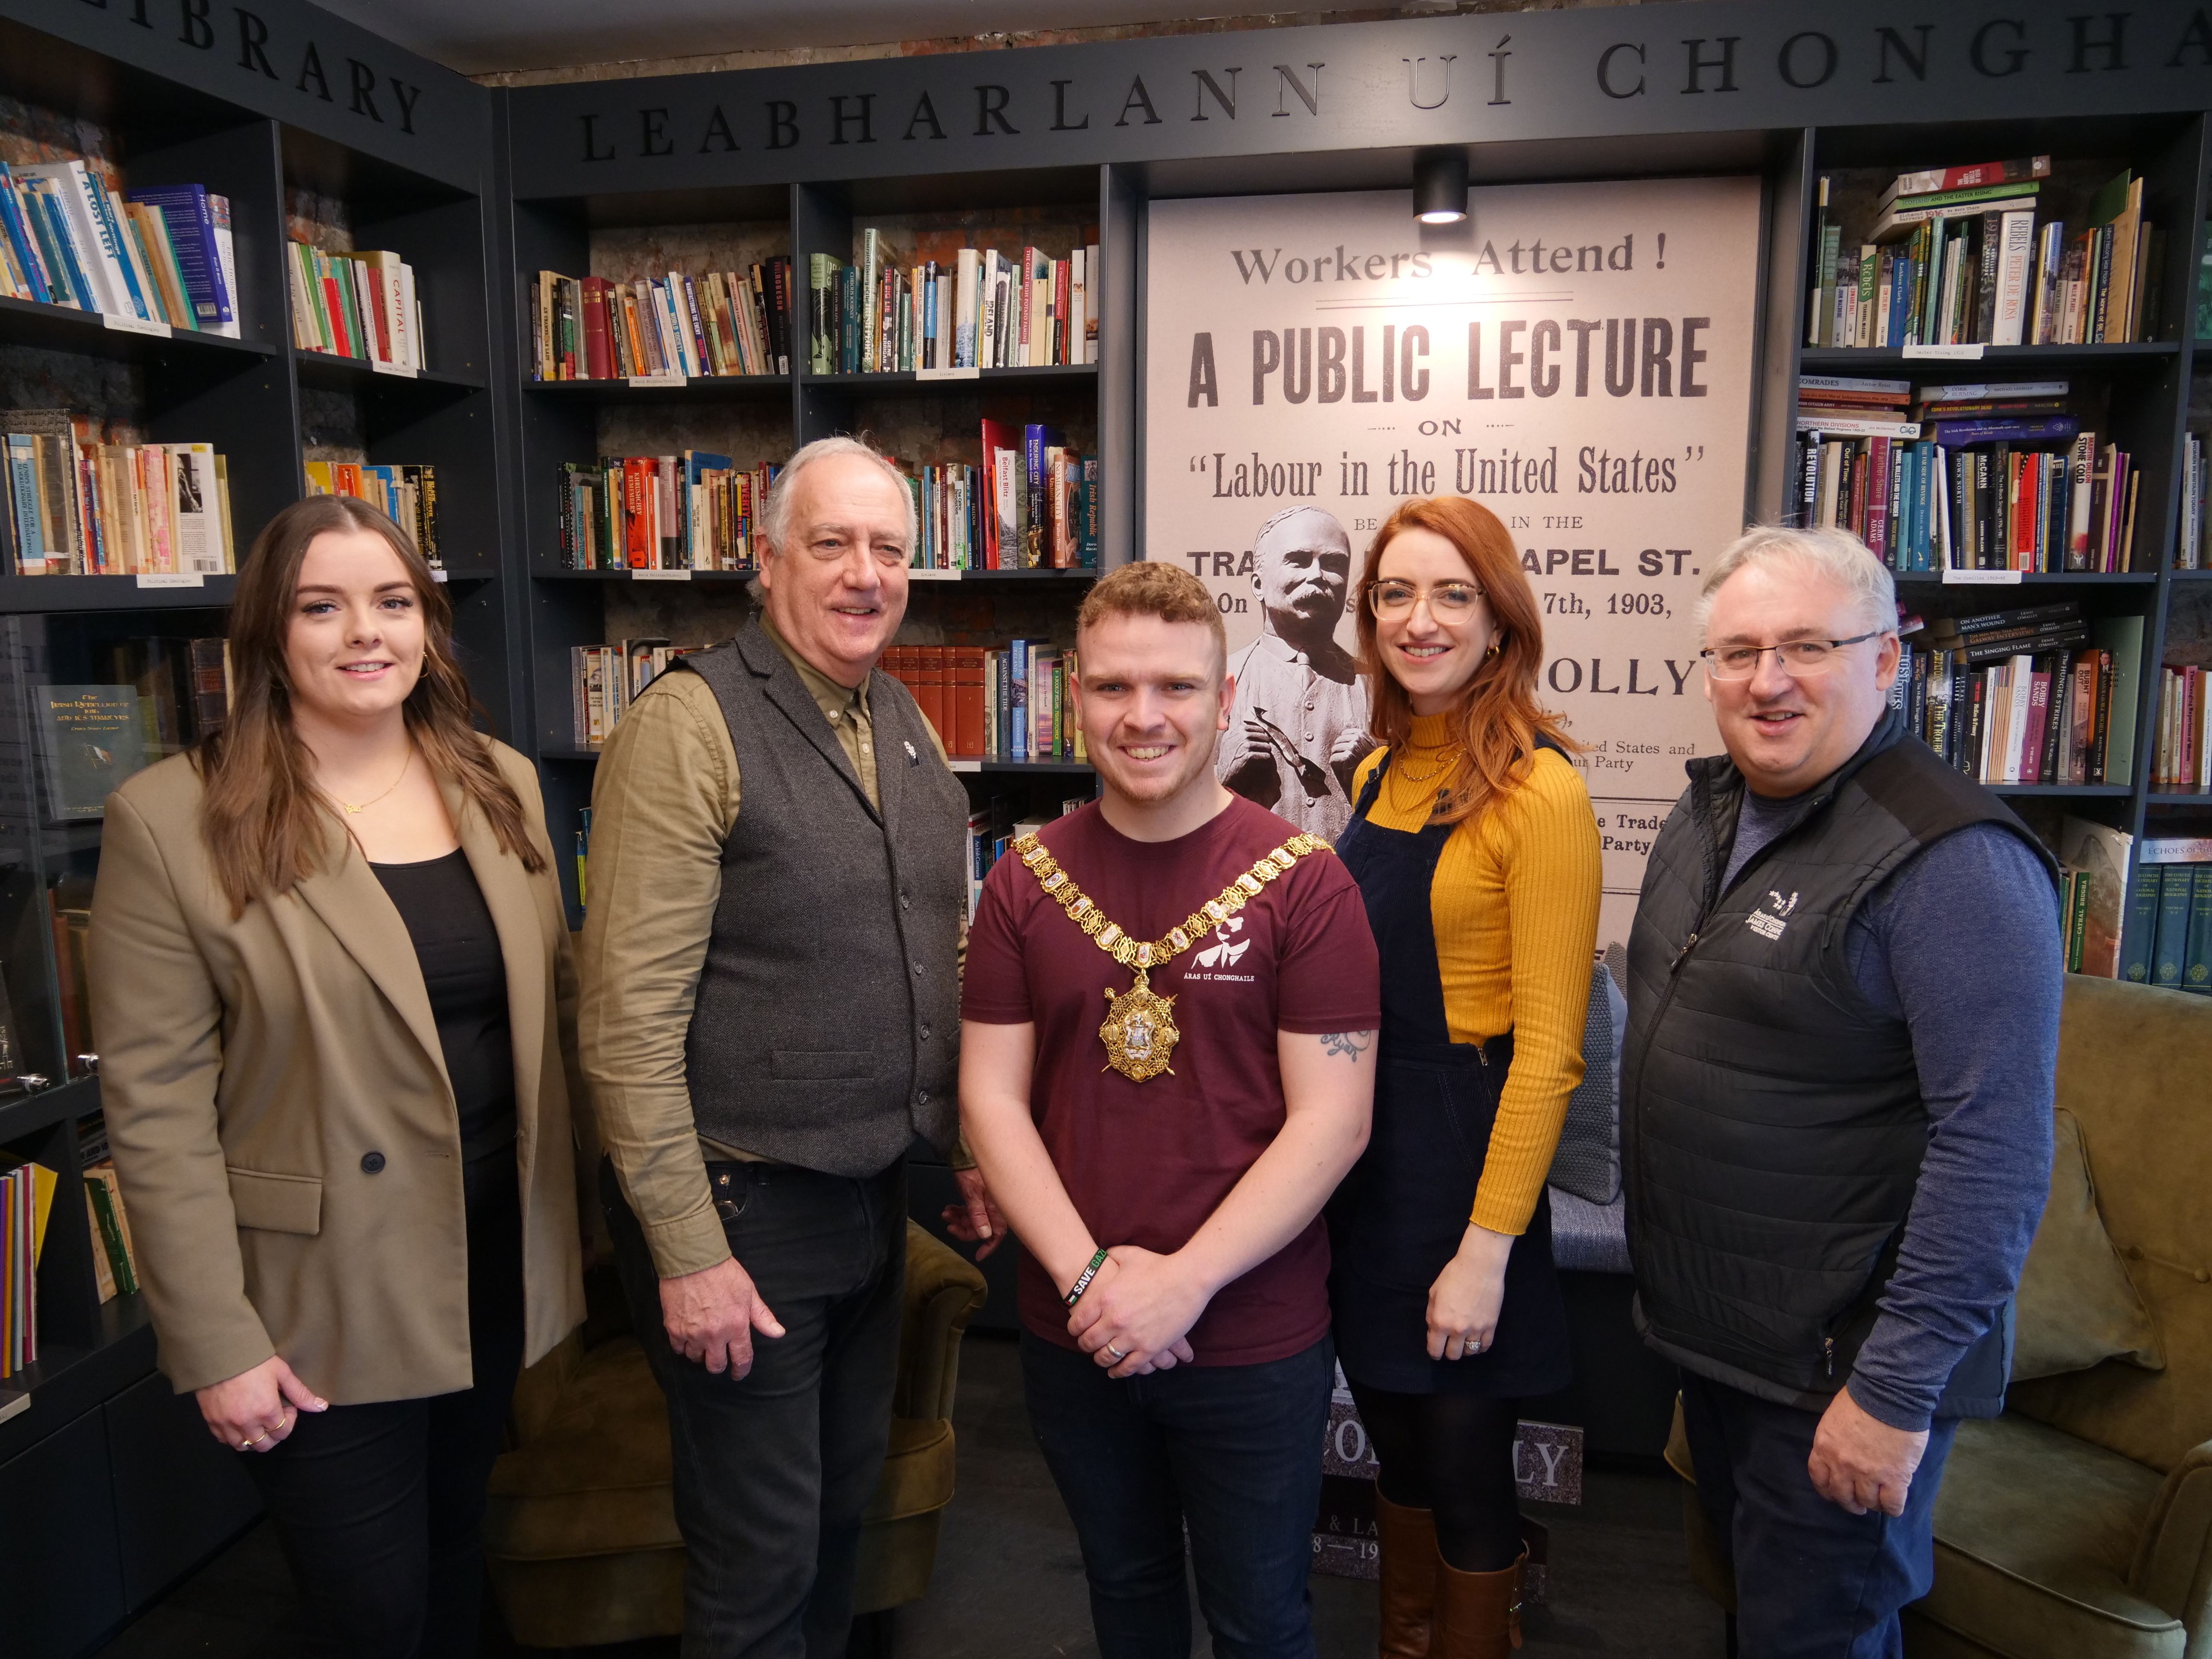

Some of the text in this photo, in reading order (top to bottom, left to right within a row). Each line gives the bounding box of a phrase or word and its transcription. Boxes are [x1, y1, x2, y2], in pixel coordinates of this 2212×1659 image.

[580, 6, 2212, 163] LEABHARLANN UÍ CHONGHA
[81, 180, 116, 259] A LOST LEFT
[198, 194, 209, 225] Home
[1230, 244, 1433, 285] Workers
[1470, 233, 1634, 276] Attend
[2005, 220, 2029, 320] REBELS PETER DE ROSA
[1861, 263, 1873, 296] Rebels
[393, 279, 404, 334] CAPITAL
[685, 282, 697, 316] MANUFACTURING
[731, 282, 739, 311] BROADWATER
[669, 312, 683, 352] WORLD SOCIETY
[985, 300, 994, 337] IRELAND
[1187, 317, 1711, 408] A PUBLIC LECTURE
[1418, 417, 1461, 437] ON
[1877, 451, 1886, 476] Farther
[2076, 437, 2087, 484] STONE COLD
[2087, 436, 2095, 463] MARTIN
[1056, 464, 1060, 473] NO
[1339, 451, 1369, 496] in
[1388, 449, 1435, 496] the
[1455, 446, 1558, 495] United
[1804, 448, 1817, 503] REVOLUTION
[741, 474, 751, 518] POVERTY
[1876, 477, 1884, 498] Shore
[17, 463, 33, 555] REVOLUTIONARY INTERNATIONAL
[1354, 516, 1583, 530] BE IN THE
[1637, 548, 1700, 576] ST.
[1217, 592, 1248, 614] On
[1607, 593, 1671, 619] 1903,
[1984, 646, 2011, 655] SINGING
[2038, 681, 2047, 708] BOBBY
[1616, 741, 1659, 754] States
[1669, 744, 1695, 755] and
[1595, 756, 1633, 772] Party
[1602, 836, 1651, 855] Party
[1214, 974, 1254, 982] CHONGHAILE
[1074, 1266, 1095, 1294] SAVE
[1330, 1514, 1341, 1532] &
